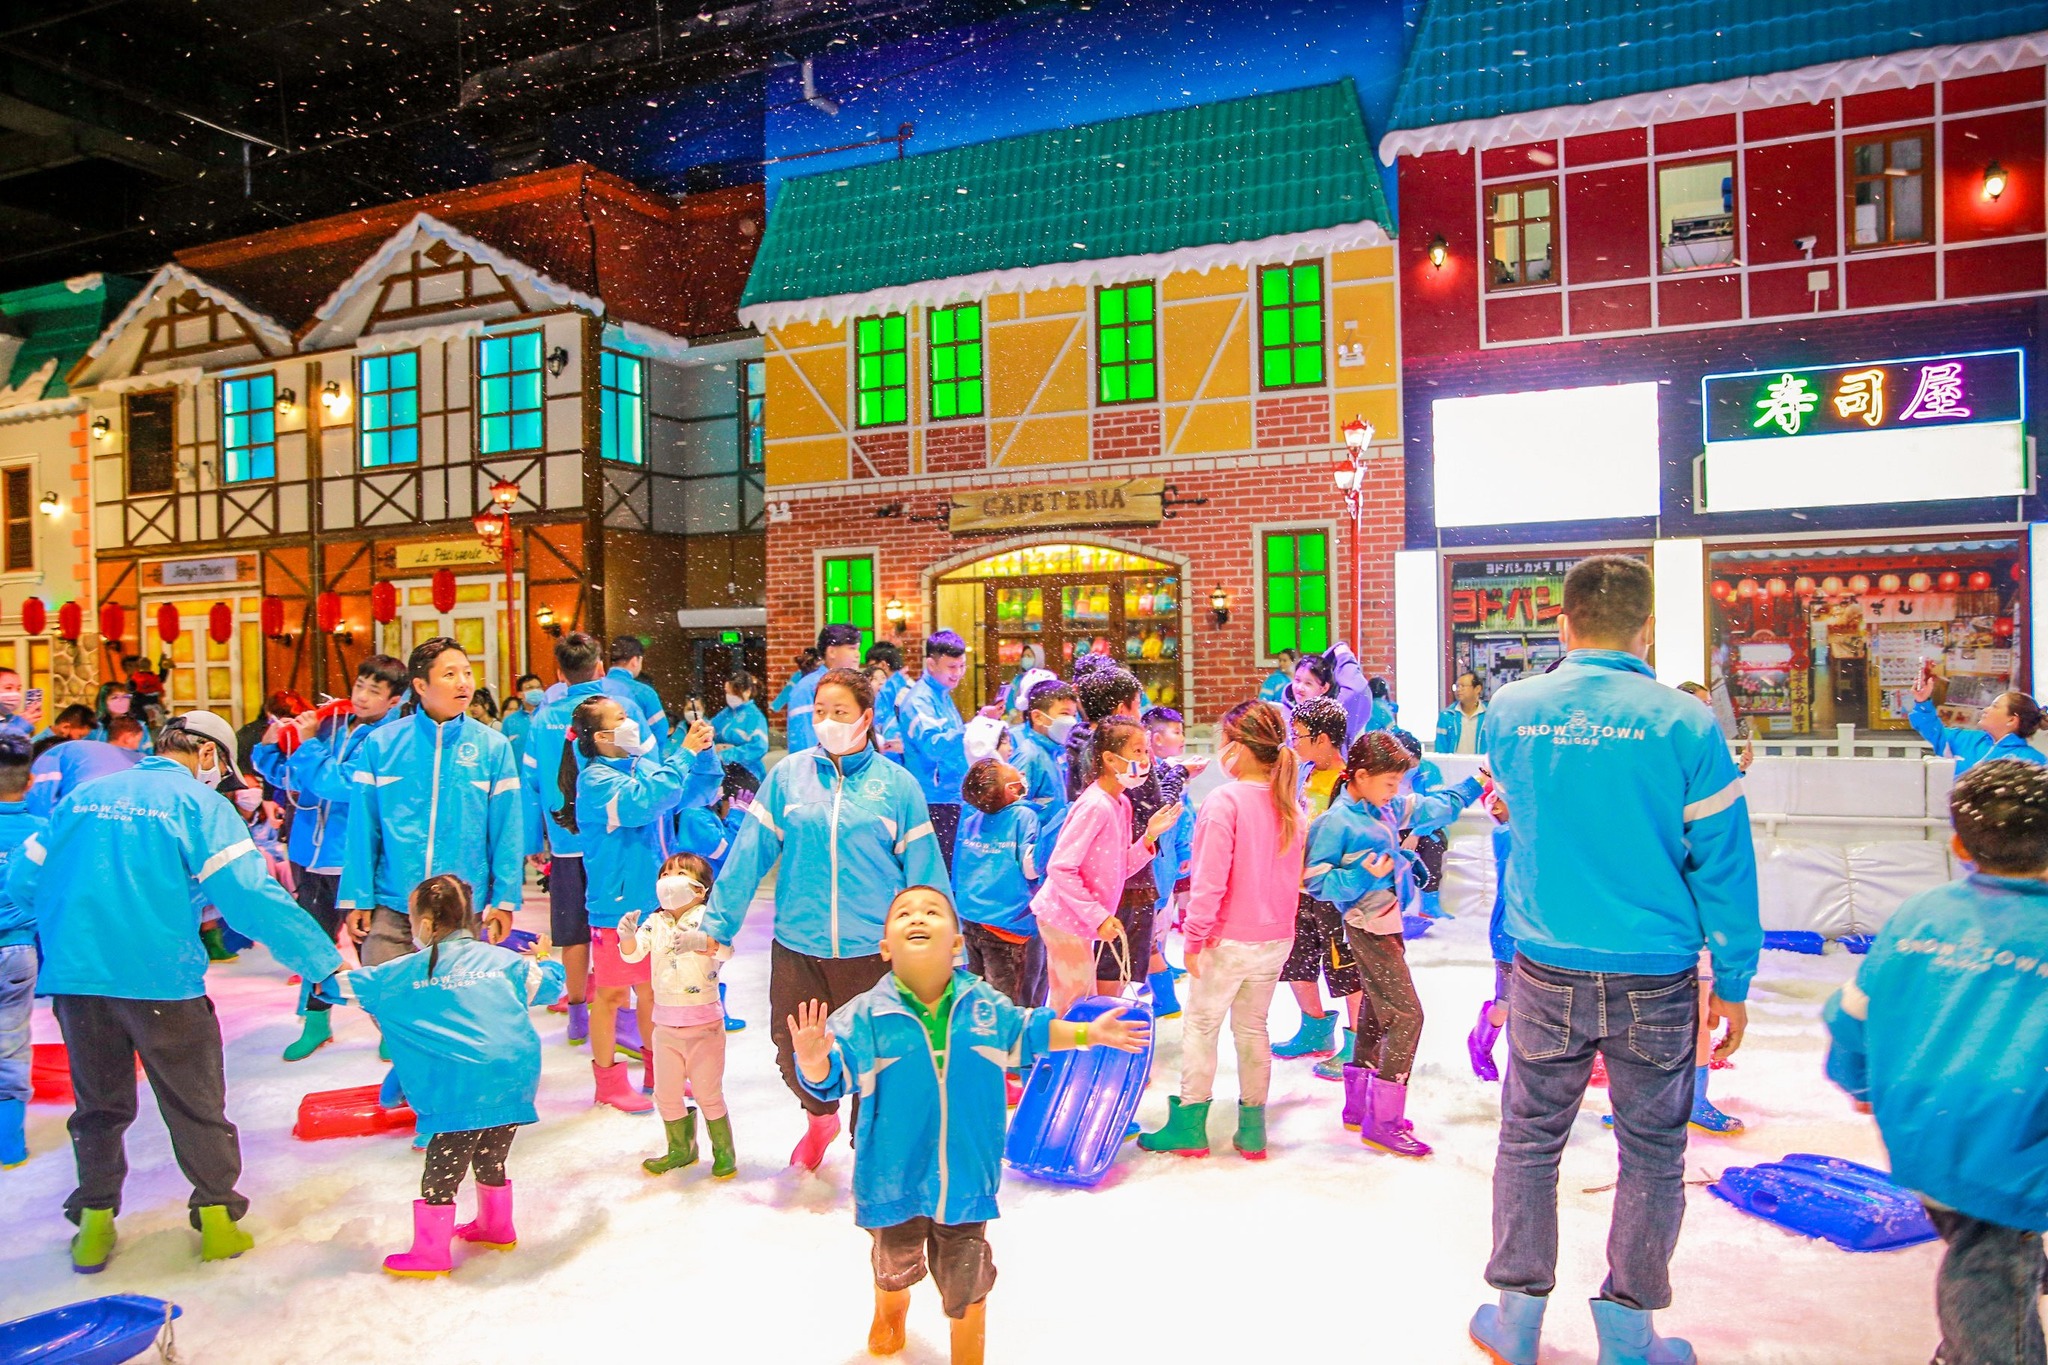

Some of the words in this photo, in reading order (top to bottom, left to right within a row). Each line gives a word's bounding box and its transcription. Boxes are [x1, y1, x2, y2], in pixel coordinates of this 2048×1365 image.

[1754, 362, 1971, 435] 寿司屋
[982, 488, 1126, 517] CAFETERIA
[1486, 561, 1551, 574] ヨドバシカメラ
[1452, 585, 1563, 623] ヨドバシ
[1517, 725, 1567, 736] SNOW
[1590, 725, 1645, 740] TOWN
[1552, 737, 1599, 746] SAIGON
[72, 803, 112, 814] SNOW
[129, 807, 169, 819] TOWN
[413, 975, 451, 989] SNOW
